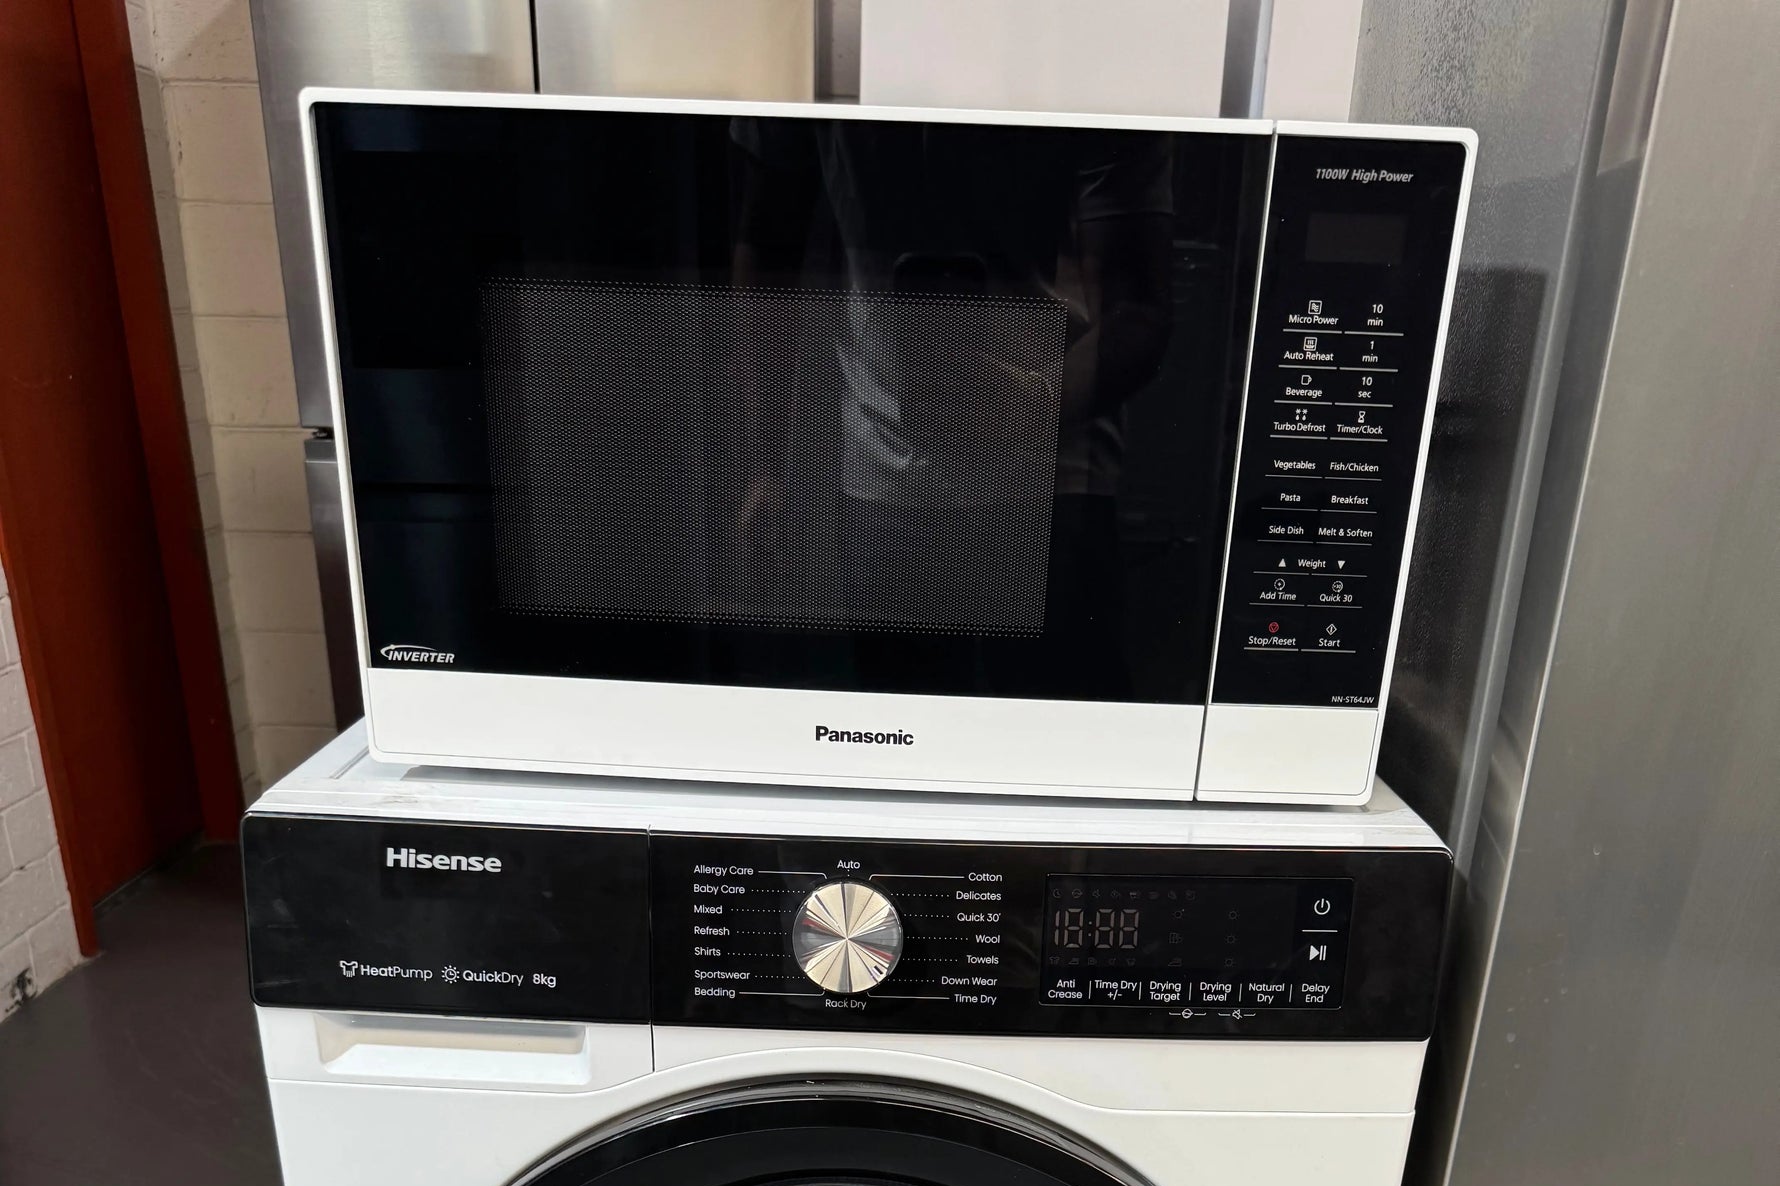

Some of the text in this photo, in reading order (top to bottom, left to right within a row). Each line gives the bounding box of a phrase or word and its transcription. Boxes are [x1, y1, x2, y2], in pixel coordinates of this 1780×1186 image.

[1316, 168, 1413, 183] 1100W High Power
[1372, 304, 1384, 314] 10
[1289, 315, 1338, 325] Micro Power
[1367, 318, 1384, 327] min
[1370, 341, 1374, 350] 1
[1284, 351, 1334, 361] Auto Reheat
[1362, 354, 1378, 363] min
[1361, 377, 1372, 386] 10
[1286, 388, 1322, 398] Beverage
[1274, 422, 1326, 432] Turbo Defrost
[1337, 424, 1383, 435] Timer/Clock
[1274, 460, 1316, 470] Vegetables
[1330, 462, 1379, 472] Fish/Chicken
[1280, 493, 1301, 502] Pasta
[1331, 495, 1368, 505] Breakfast
[1269, 526, 1304, 535] Side Dish
[1318, 527, 1373, 537] Melt & Soften
[1298, 559, 1326, 569] Weight
[1260, 592, 1296, 601] Add Time
[1320, 593, 1352, 602] Quick 30
[1248, 636, 1296, 646] Stop/Reset
[1319, 638, 1340, 647] Start
[388, 650, 455, 663] INVERTER
[815, 725, 914, 746] Panasonic
[386, 848, 502, 872] Hisense
[837, 860, 860, 869] Auto
[694, 865, 754, 876] Allergy Care
[968, 872, 1002, 882] Cotton
[694, 884, 745, 895] Baby Care
[956, 891, 1002, 901] Delicates
[694, 905, 722, 914] Mixed
[957, 913, 985, 922] Quick
[694, 926, 730, 936] Refresh
[975, 934, 1000, 944] Wool
[694, 947, 721, 956] Shirts
[966, 955, 999, 964] Towels
[533, 973, 556, 987] 8kg
[694, 970, 750, 980] Sportswear
[941, 976, 998, 986] Down Wear
[1056, 979, 1076, 988] Anti
[1095, 980, 1137, 991] Time Dry
[1150, 981, 1182, 992] Drying
[1200, 982, 1232, 993] Drying
[1248, 983, 1285, 992] Natural
[1302, 983, 1330, 994] Delay
[694, 987, 736, 998] Bedding
[1048, 990, 1083, 998] Crease
[1150, 992, 1181, 1002] Target
[1203, 993, 1227, 1001] Level
[954, 994, 997, 1005] Time Dry
[1257, 994, 1274, 1004] Dry
[1305, 994, 1324, 1003] End
[825, 999, 866, 1010] Rack Dry
